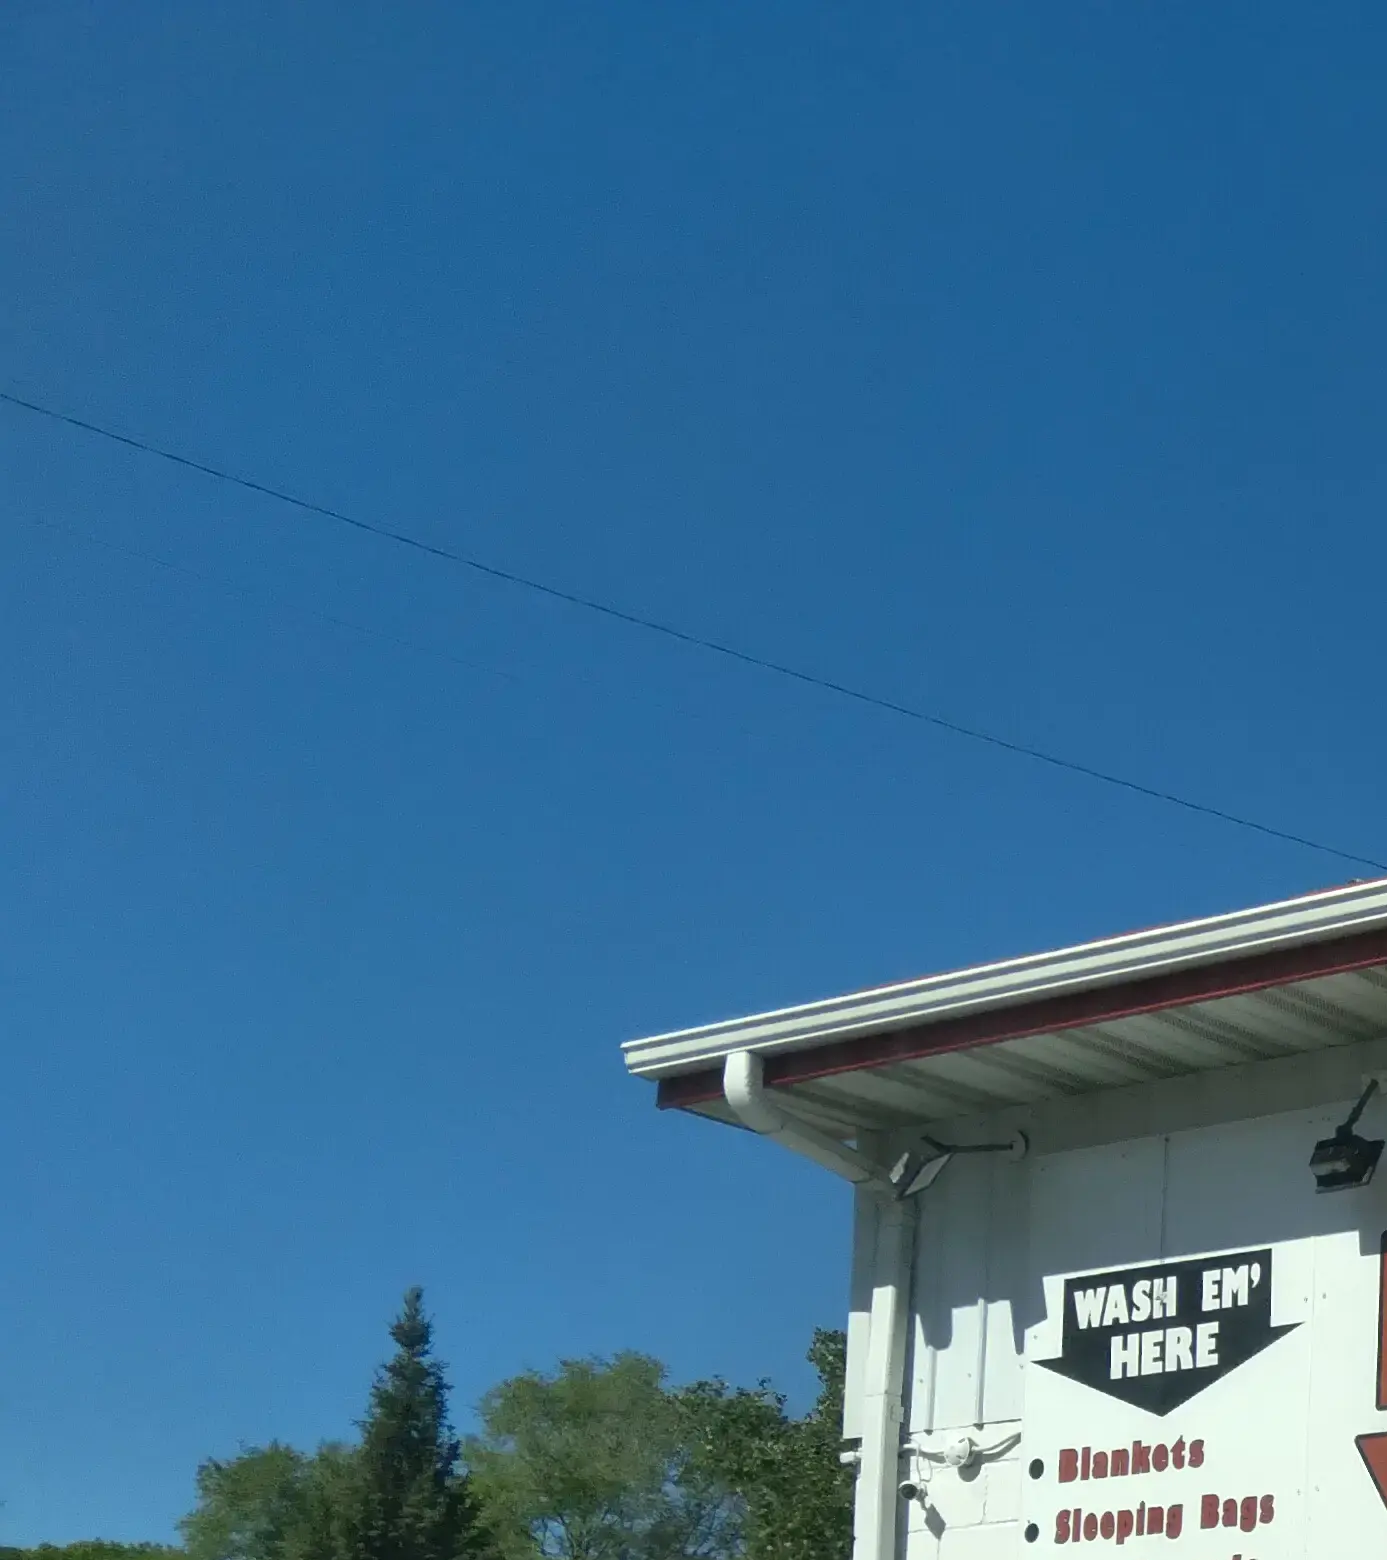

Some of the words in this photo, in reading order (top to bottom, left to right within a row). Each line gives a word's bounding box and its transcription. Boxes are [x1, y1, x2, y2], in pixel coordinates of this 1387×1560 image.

[1073, 1275, 1178, 1331] WASH
[1201, 1261, 1262, 1312] EM'
[1109, 1321, 1219, 1380] HERE
[1057, 1434, 1206, 1483] Blankets
[1053, 1500, 1184, 1546] Sleeping
[1199, 1493, 1275, 1533] Bags
